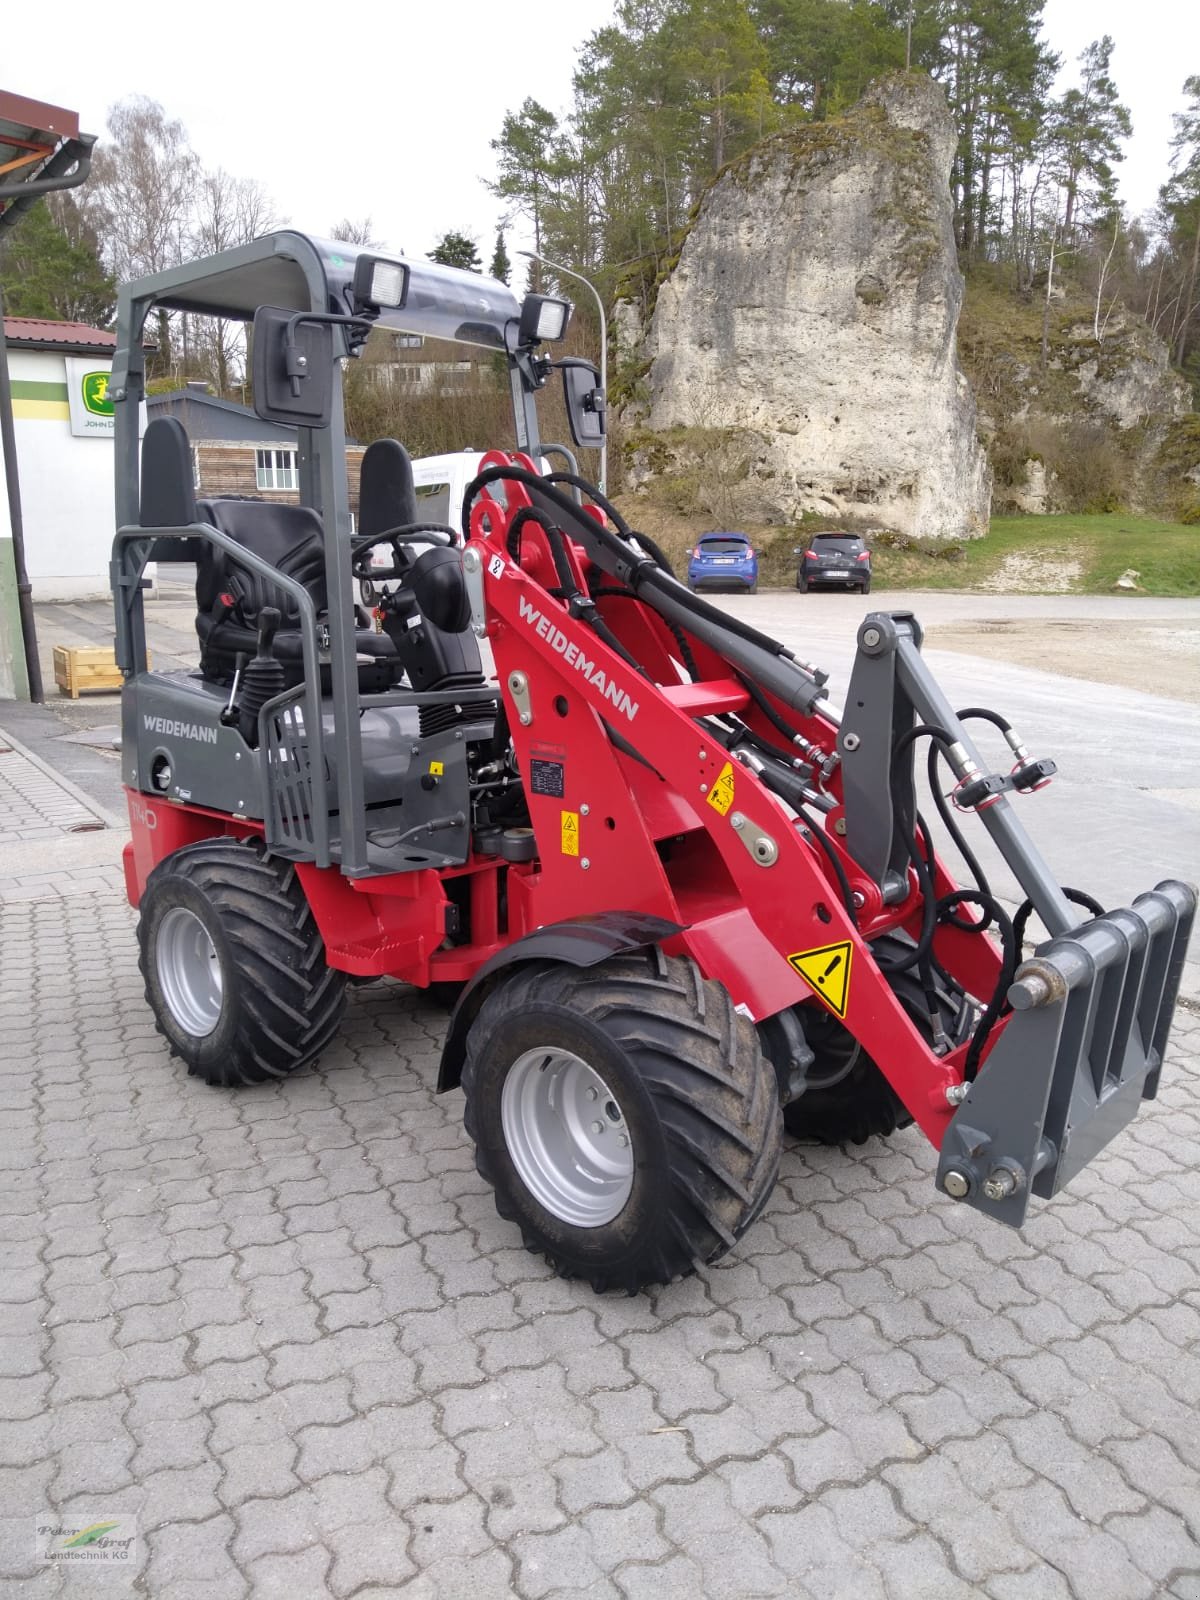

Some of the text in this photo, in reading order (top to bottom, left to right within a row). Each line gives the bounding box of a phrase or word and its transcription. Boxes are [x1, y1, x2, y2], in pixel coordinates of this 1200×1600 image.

[84, 420, 107, 428] JOHN
[519, 594, 640, 722] WEIDEMANN
[143, 714, 218, 744] WEIDEMANN
